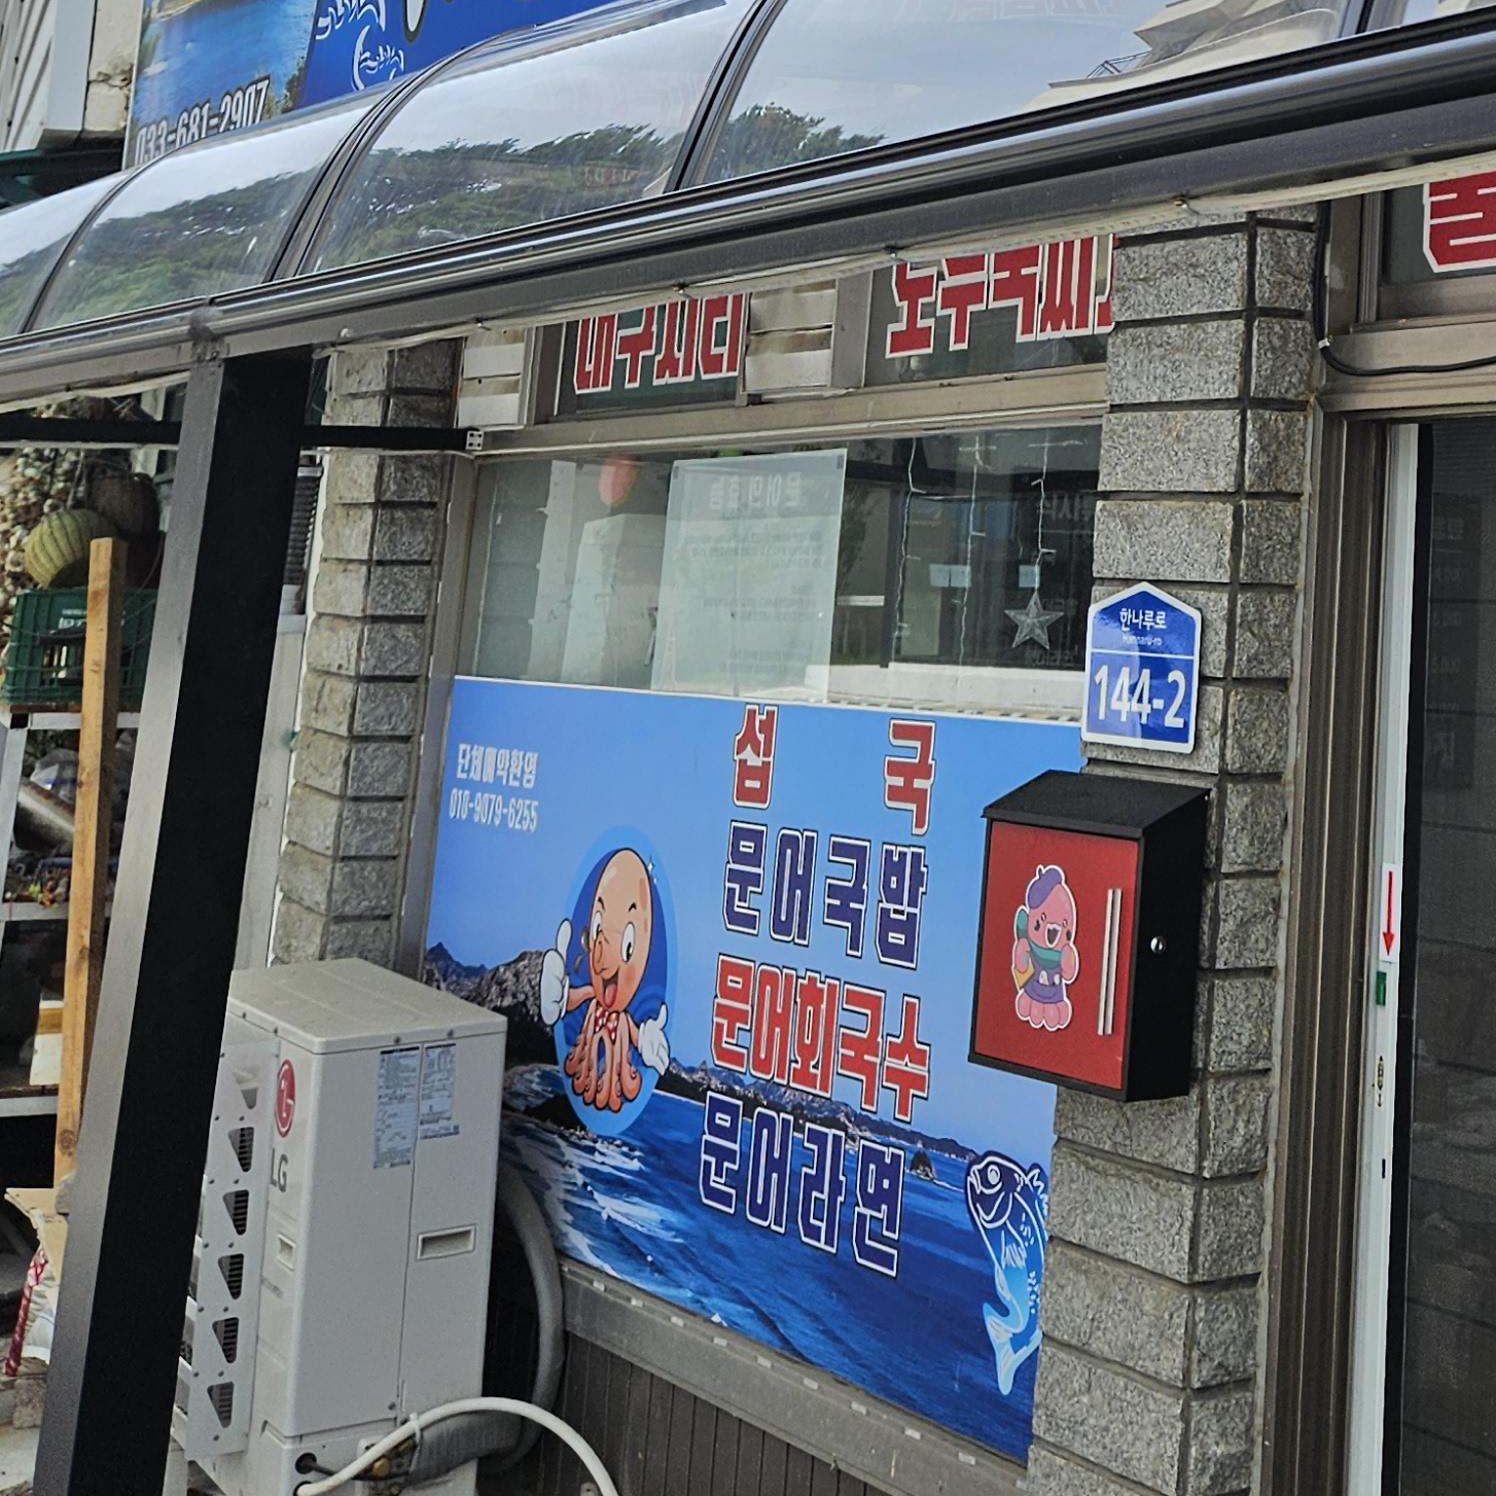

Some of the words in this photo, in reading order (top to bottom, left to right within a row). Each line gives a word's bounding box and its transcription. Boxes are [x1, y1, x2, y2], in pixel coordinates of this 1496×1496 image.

[1119, 607, 1167, 632] 한나루로
[1094, 664, 1187, 729] 144-2
[723, 819, 928, 971] 문어국밥
[710, 953, 933, 1123] 문어회국수
[270, 1147, 289, 1193] LG
[699, 1091, 907, 1279] 문어라면
